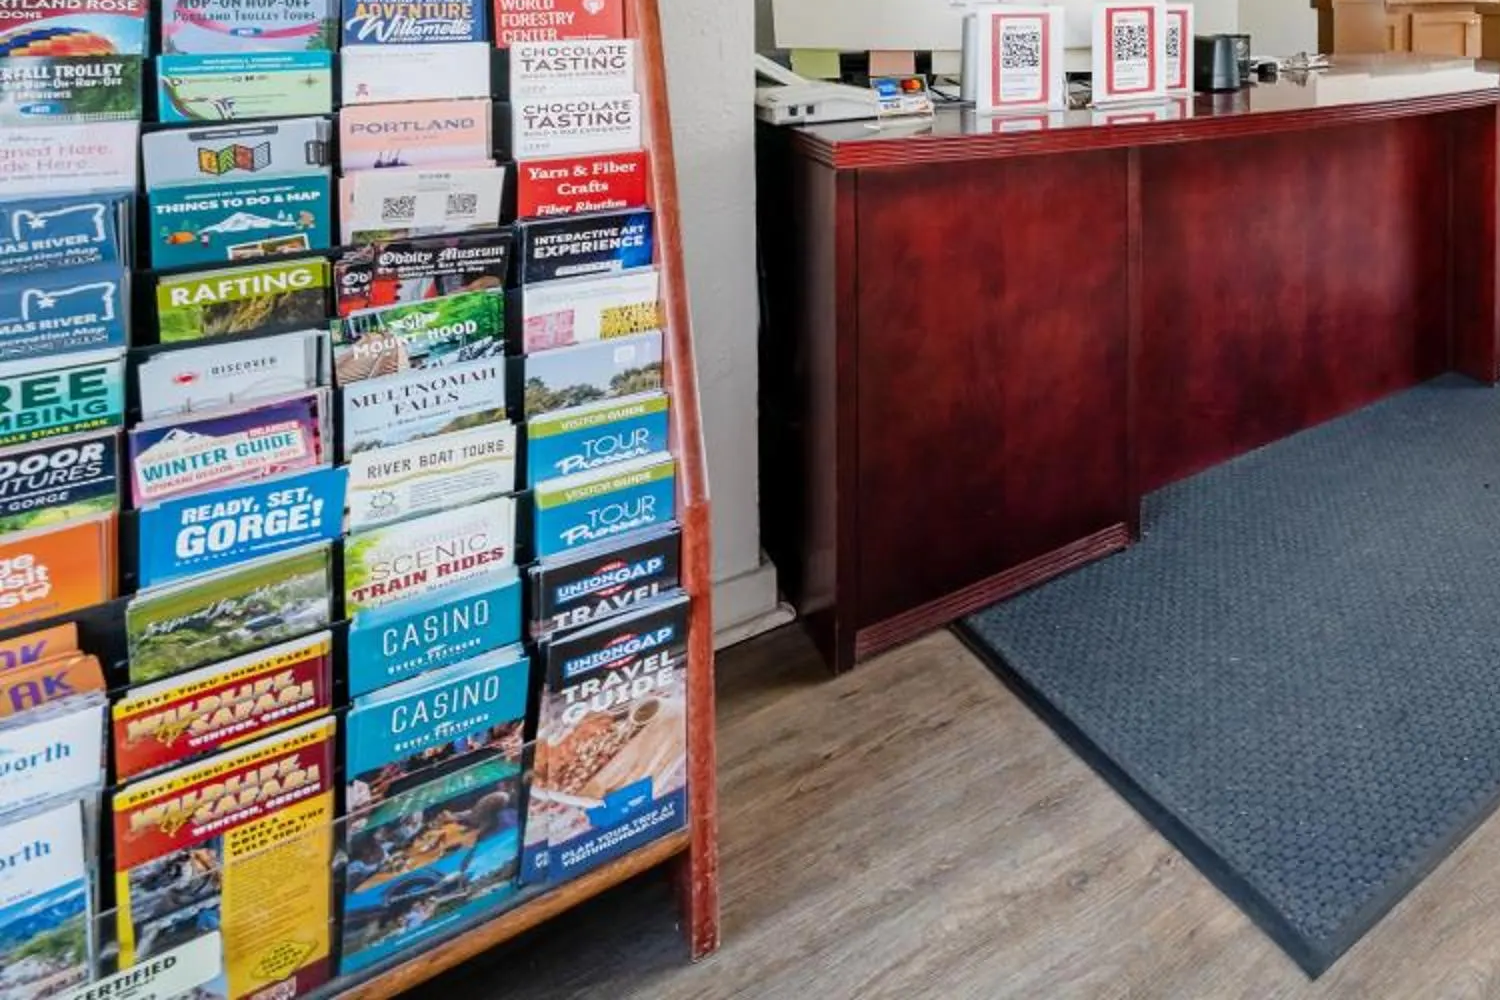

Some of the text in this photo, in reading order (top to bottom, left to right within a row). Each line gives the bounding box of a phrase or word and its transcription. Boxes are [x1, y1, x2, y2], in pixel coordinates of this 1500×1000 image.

[355, 3, 473, 19] ADVENTURE
[501, 11, 576, 28] FORESTRY
[344, 13, 475, 42] Willamette
[502, 27, 558, 44] CENTER
[520, 45, 628, 58] CHOCOLATE
[55, 63, 125, 78] TROLLEY
[521, 56, 627, 73] TASTING
[523, 99, 633, 115] CHOCOLATE
[351, 117, 476, 136] PORTLAND
[523, 111, 632, 130] TASTING
[527, 161, 637, 180] Yarn & Fiber
[556, 179, 609, 196] Crafts
[155, 197, 219, 215] THINGS
[221, 198, 243, 208] TO
[246, 196, 271, 206] DO
[287, 191, 321, 201] MAP
[536, 204, 573, 217] Fiber
[31, 233, 90, 250] RIVER
[533, 235, 644, 259] EXPERIENCE
[534, 225, 645, 246] INTERACTIVE ART
[170, 268, 313, 308] RAFTING
[39, 312, 97, 329] RIVER
[427, 319, 478, 340] HOOD
[210, 355, 278, 376] DISCOVER
[351, 367, 496, 409] MULTNOMAH
[393, 391, 460, 416] FALLS
[581, 426, 650, 458] TOUR
[141, 433, 297, 482] WINTER GUIDE
[367, 439, 506, 480] RIVER BOAT TOURS
[8, 491, 70, 512] GORGE
[180, 486, 314, 527] READY, SET,
[587, 494, 656, 527] TOUR
[175, 498, 325, 559] GORGE!
[370, 532, 489, 583] SCENIC
[351, 569, 428, 604] TRAIN
[436, 546, 505, 578] RIDES
[552, 582, 662, 631] TRAVEL
[382, 599, 489, 657] CASINO
[561, 650, 676, 703] TRAVEL
[390, 674, 500, 734] CASINO
[561, 666, 675, 724] GUIDE
